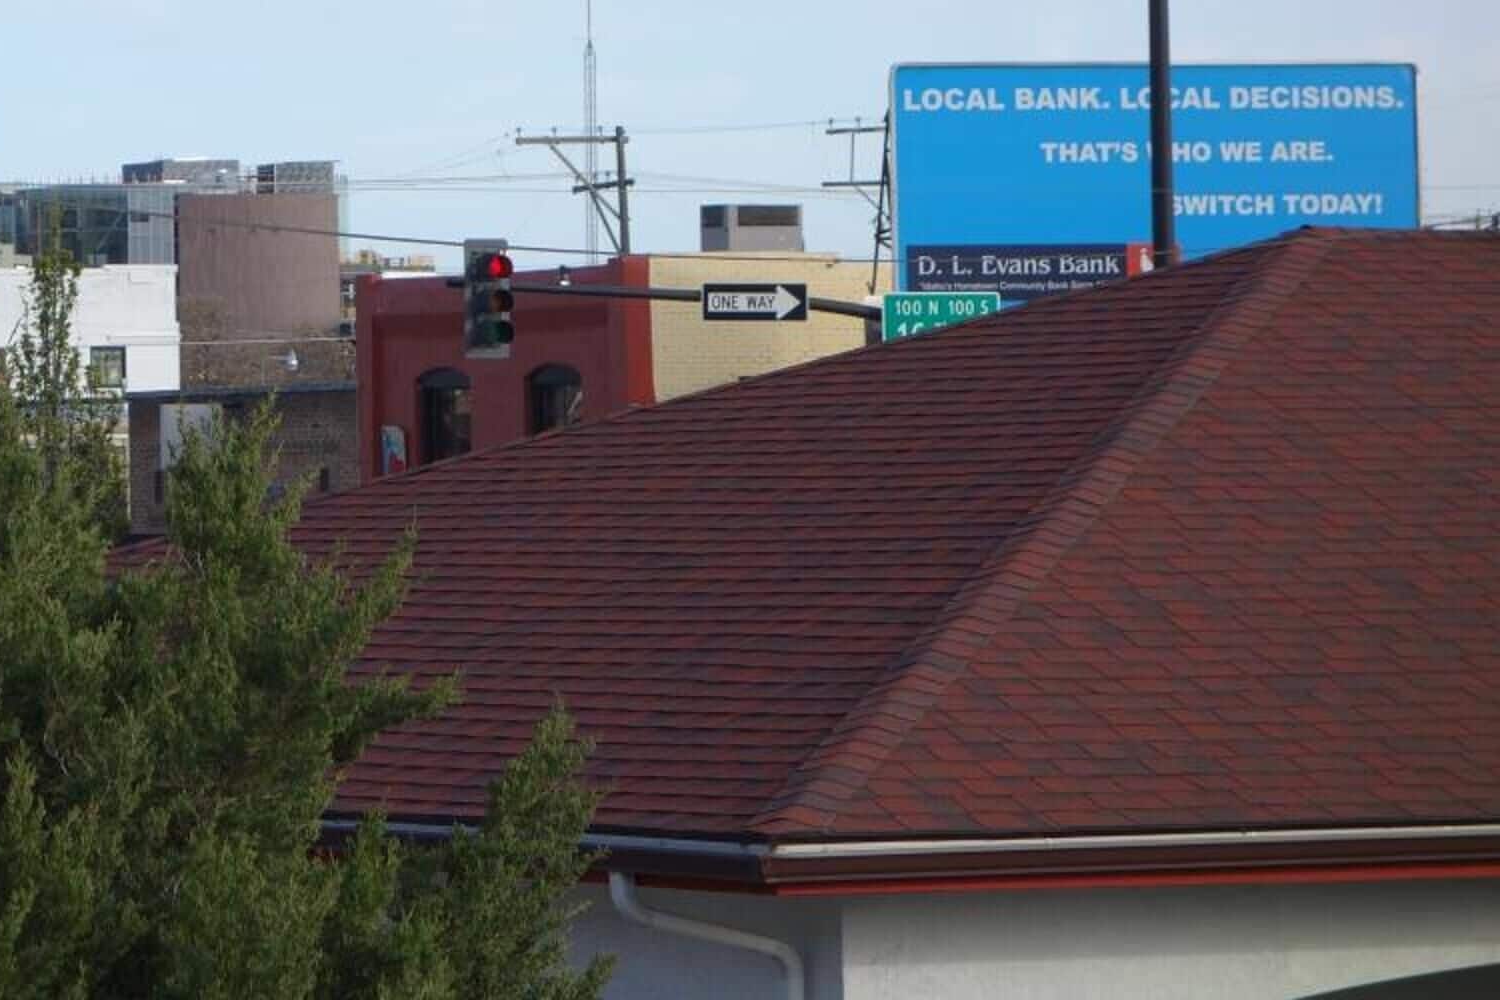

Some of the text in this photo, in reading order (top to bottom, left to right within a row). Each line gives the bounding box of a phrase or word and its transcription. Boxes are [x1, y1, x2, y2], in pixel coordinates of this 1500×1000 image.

[903, 88, 1005, 112] LOCAL
[1014, 87, 1111, 110] BANK.
[1229, 85, 1405, 109] DECISIONS.
[1040, 141, 1334, 163] THAT'S HO WE ARE.
[1283, 193, 1383, 215] TODAY!
[918, 254, 1120, 275] D. L. Evans Bank
[711, 295, 776, 309] ONE WAY
[895, 299, 990, 316] 100 N 100 S
